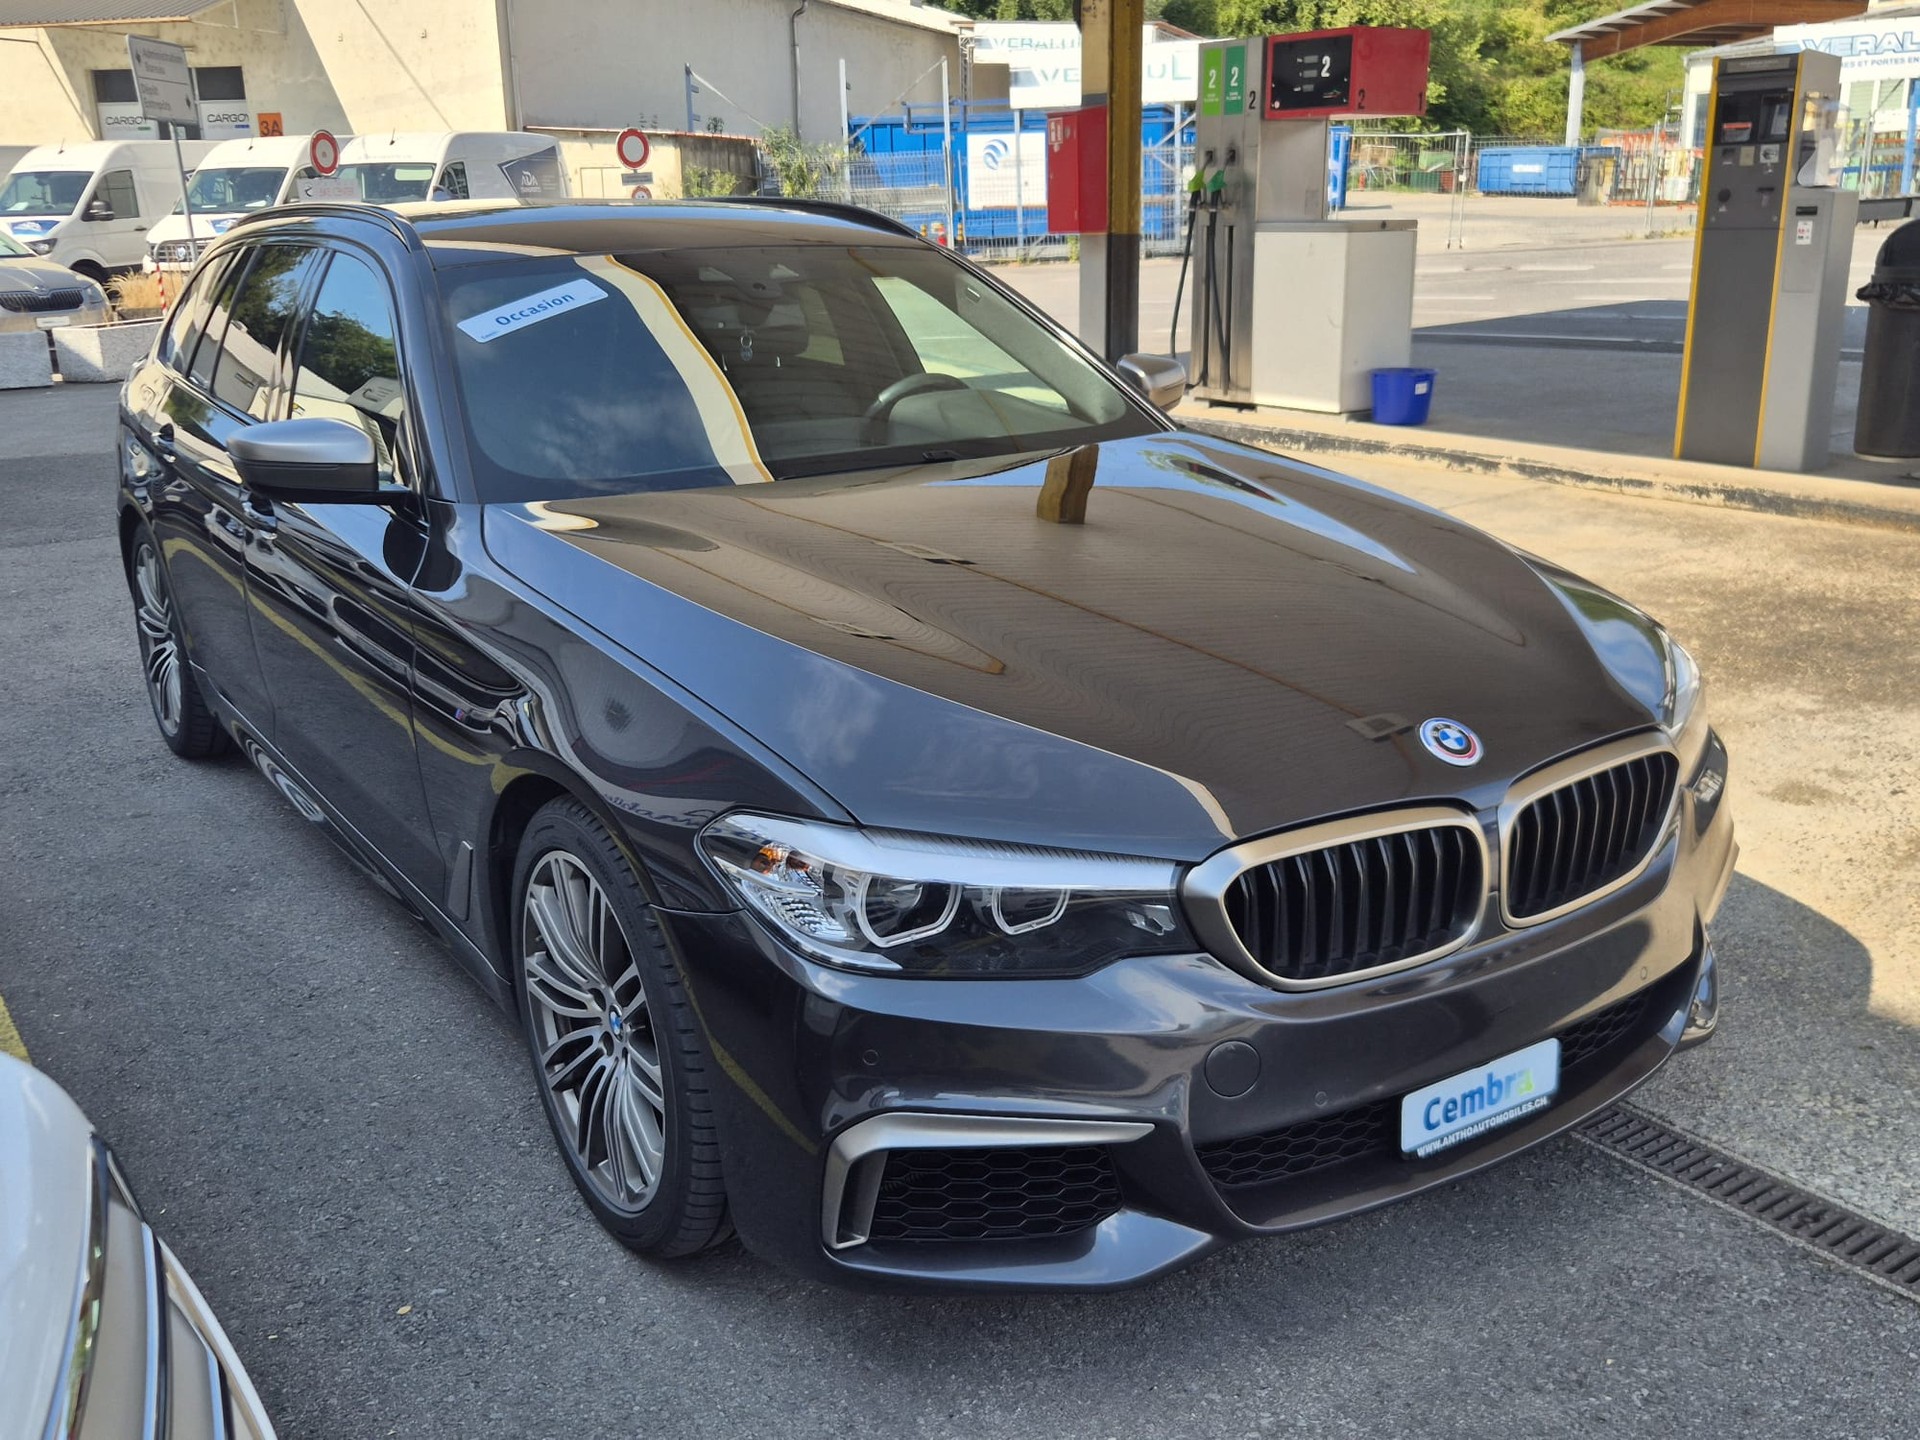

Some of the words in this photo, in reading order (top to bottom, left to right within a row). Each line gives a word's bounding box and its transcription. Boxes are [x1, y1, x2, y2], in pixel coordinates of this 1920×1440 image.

[1230, 66, 1239, 87] 2
[1320, 55, 1331, 78] 2
[1208, 69, 1217, 89] 2
[1249, 90, 1256, 110] 2
[1358, 88, 1366, 110] 2
[1418, 91, 1423, 111] 1
[260, 120, 283, 136] 3A
[495, 293, 575, 326] Occasion
[1423, 1068, 1534, 1131] Cembra
